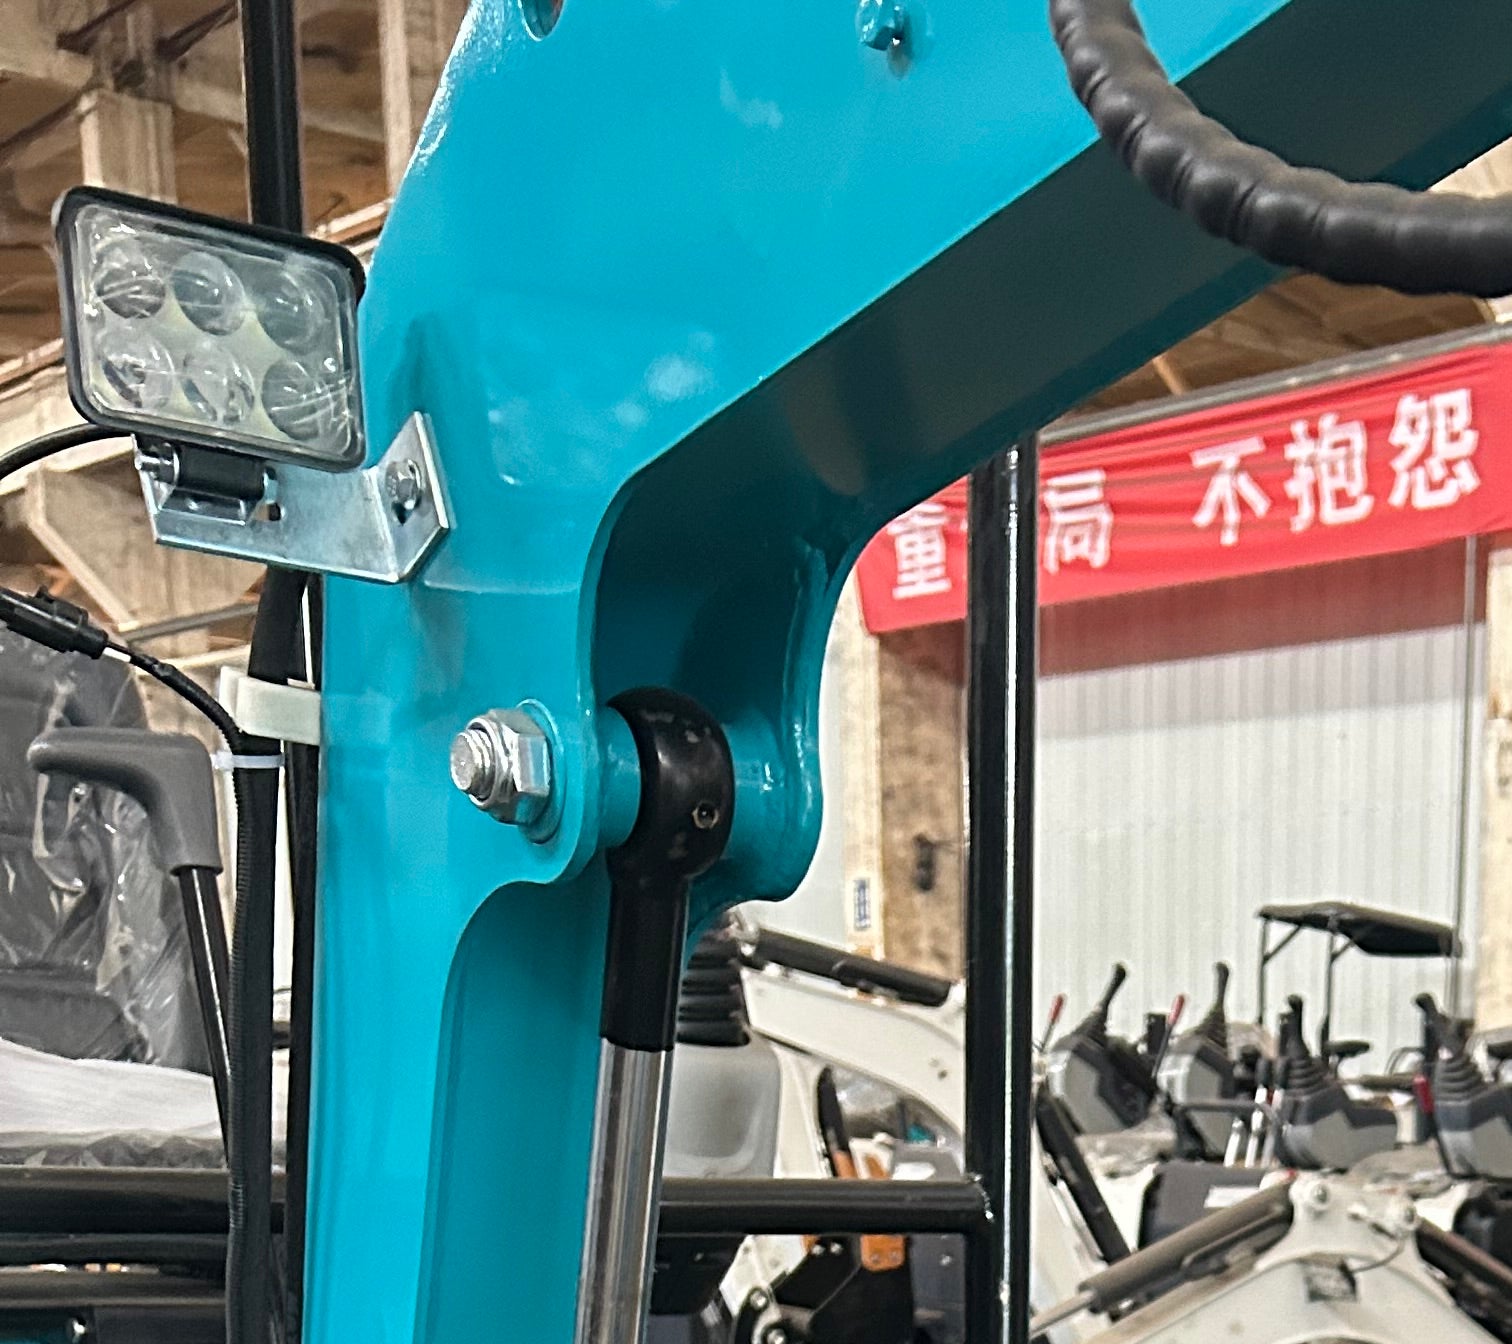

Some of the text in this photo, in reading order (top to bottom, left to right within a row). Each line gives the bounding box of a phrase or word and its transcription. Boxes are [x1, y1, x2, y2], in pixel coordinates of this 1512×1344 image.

[887, 469, 1114, 600] 重局
[1190, 388, 1481, 546] 不抱怨
